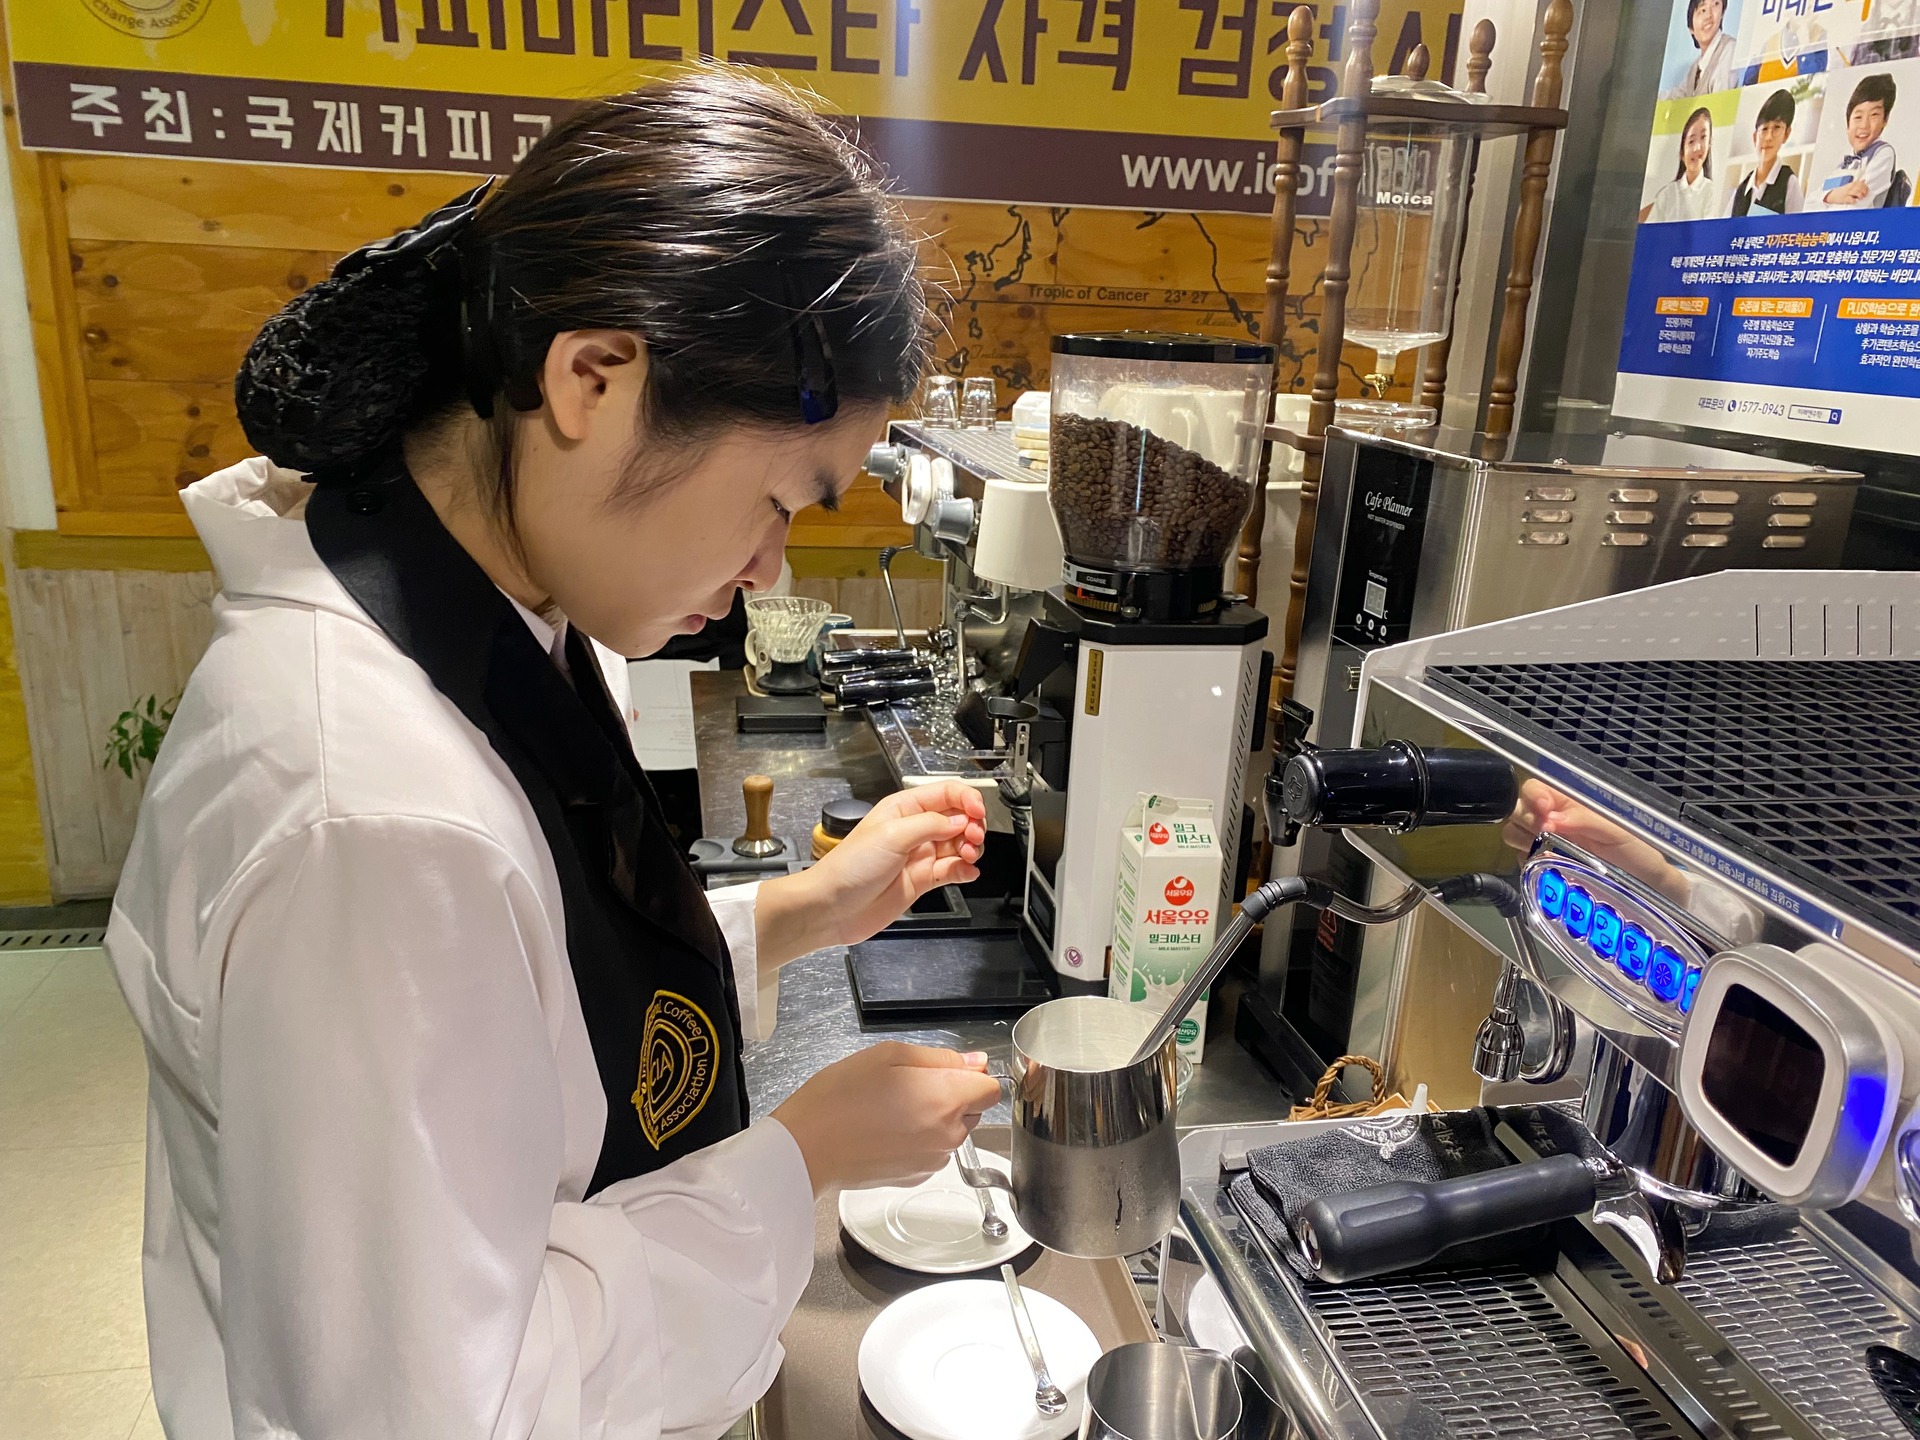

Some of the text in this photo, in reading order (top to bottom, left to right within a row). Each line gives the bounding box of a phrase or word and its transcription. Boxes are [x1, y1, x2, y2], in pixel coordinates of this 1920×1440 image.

[1376, 191, 1433, 205] Moica
[1801, 251, 1826, 265] 그리고
[1859, 249, 1897, 263] 전문가의
[1890, 269, 1920, 284] 바입니
[1028, 284, 1074, 300] Tropic
[1077, 287, 1092, 299] of
[1096, 286, 1150, 301] Cancer
[1739, 400, 1785, 417] 1577-0943
[1365, 490, 1414, 517] Cafe Planner
[1090, 652, 1099, 712] TITANIUM
[1173, 823, 1197, 834] 밀크
[1176, 834, 1212, 844] 마스터
[1143, 909, 1210, 925] 서울우유
[1149, 933, 1202, 944] 밀크마스터
[662, 1001, 703, 1038] Coffee
[660, 1057, 708, 1132] Association
